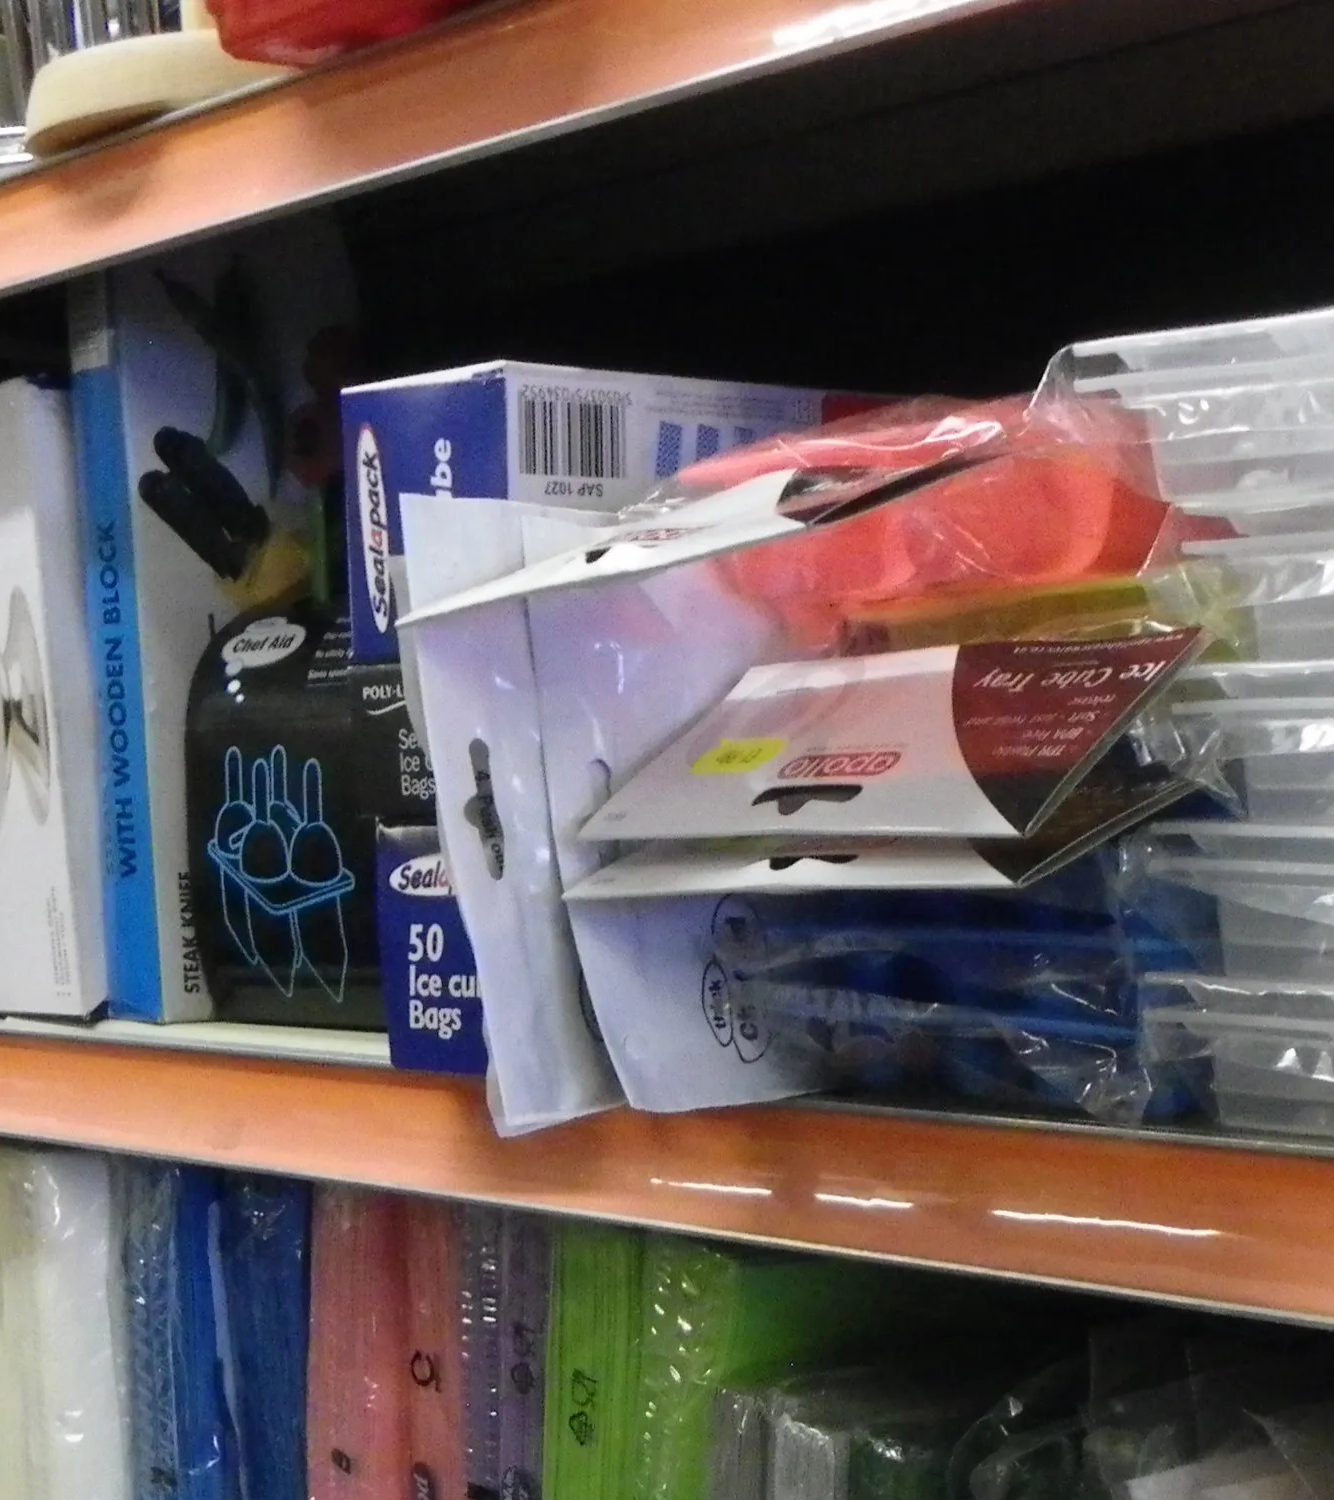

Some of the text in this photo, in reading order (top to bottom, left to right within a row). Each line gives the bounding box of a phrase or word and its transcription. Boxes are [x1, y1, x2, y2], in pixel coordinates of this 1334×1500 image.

[544, 480, 604, 497] SAP 1027
[362, 451, 389, 622] Sealapack
[233, 634, 295, 653] Chef Aid
[973, 660, 1167, 693] Ice Cube Tray
[98, 520, 137, 879] WITH WOODEN BLOCK
[781, 752, 897, 778] apollo
[401, 775, 436, 798] Bags
[407, 923, 444, 962] 50
[182, 940, 200, 995] STEAK
[409, 966, 442, 998] Ice
[409, 1001, 462, 1040] Bags
